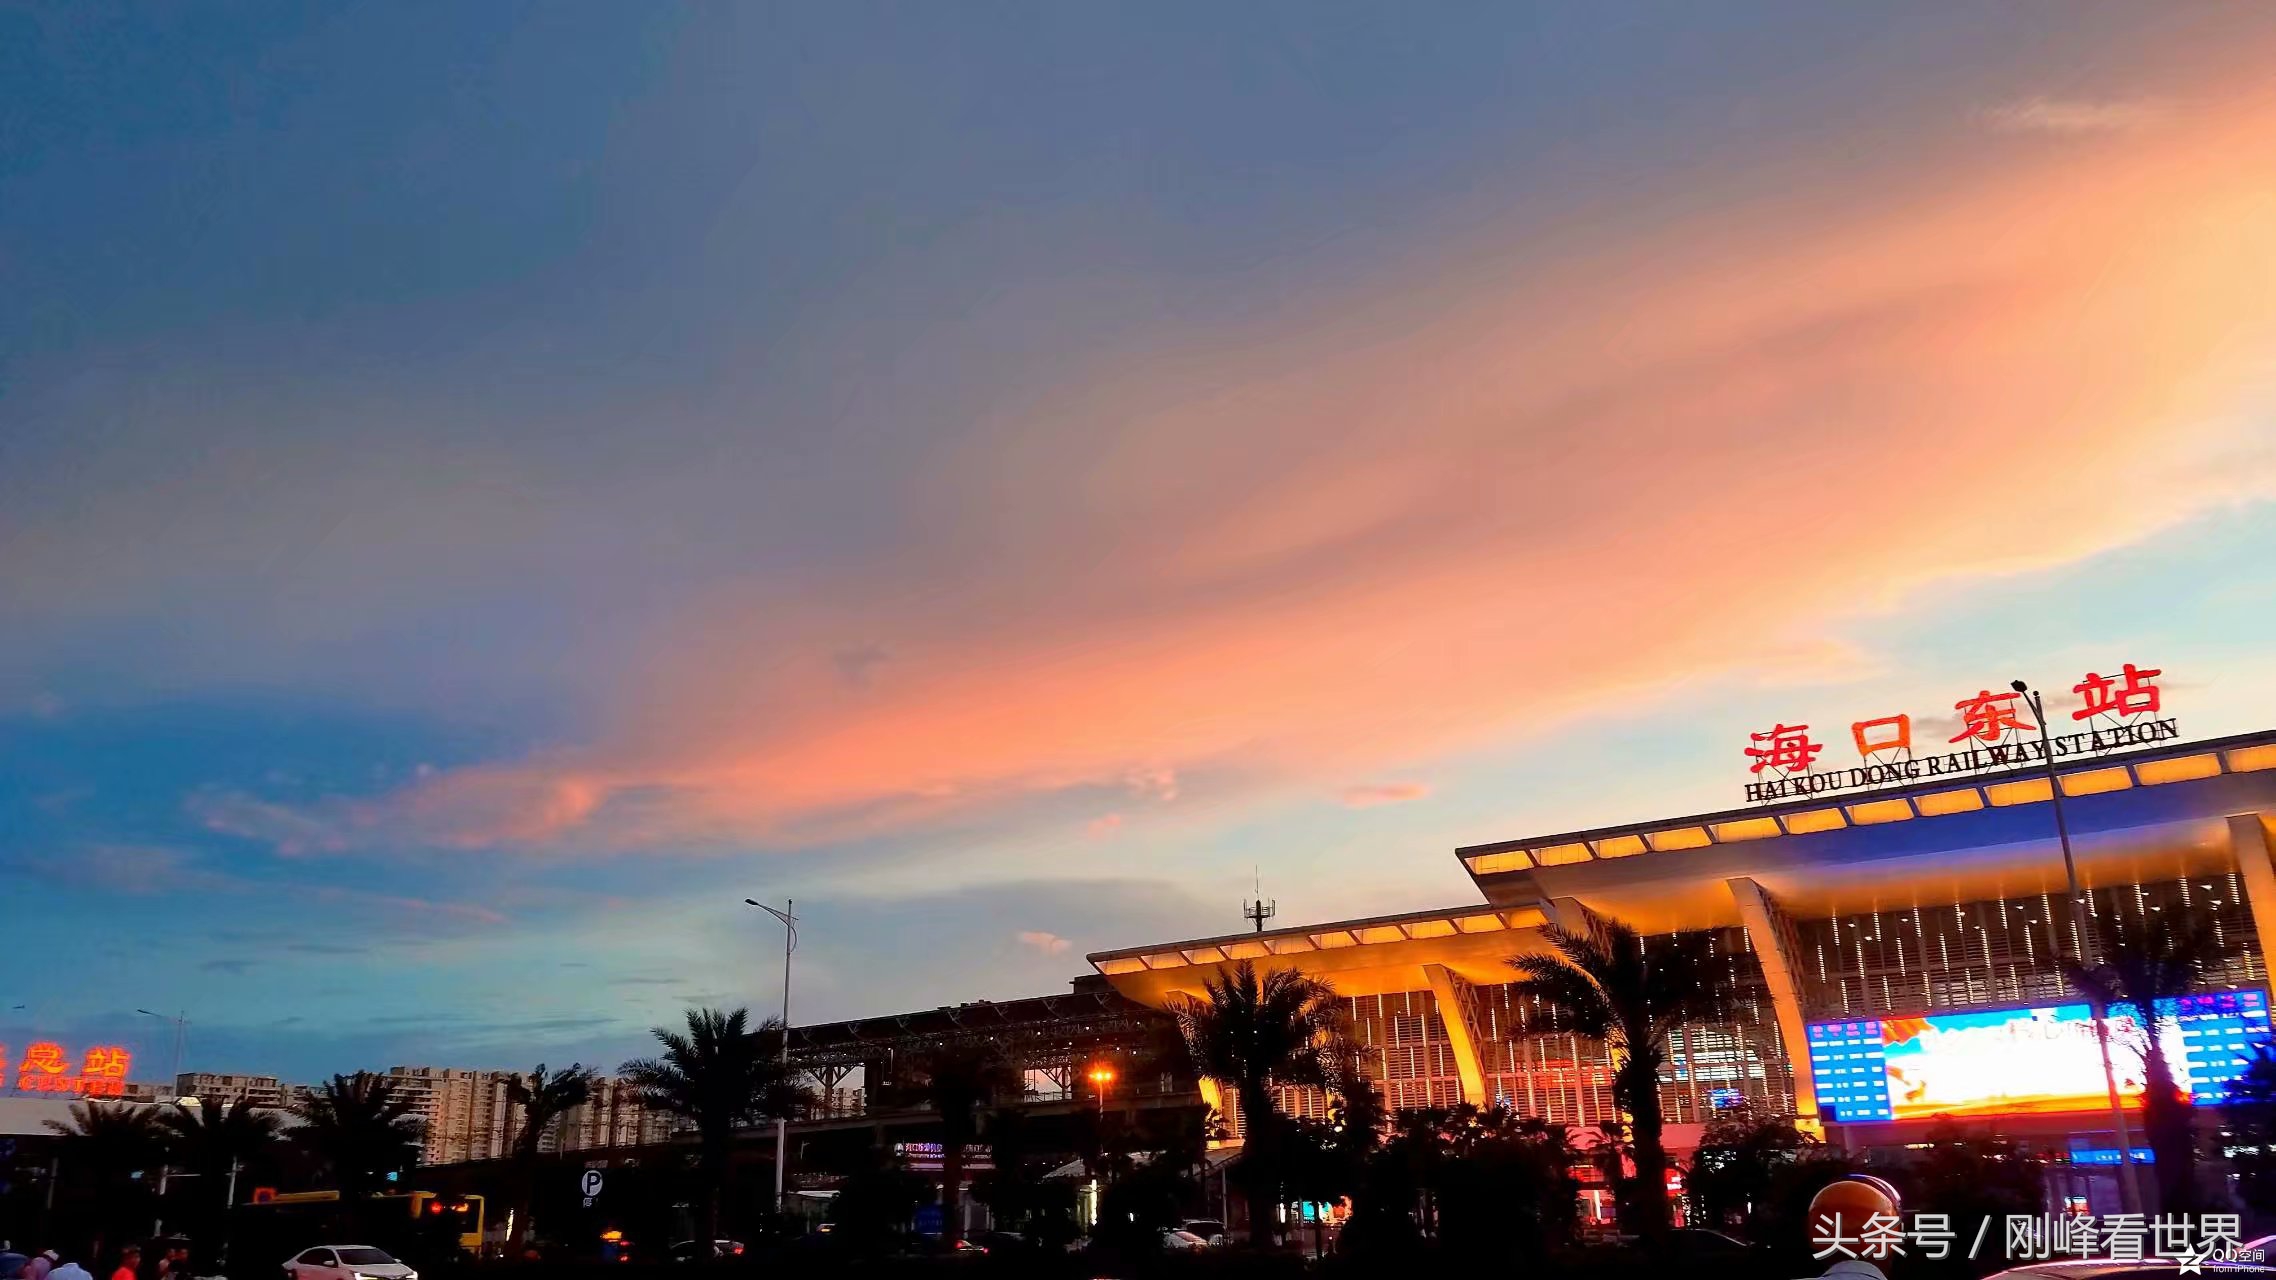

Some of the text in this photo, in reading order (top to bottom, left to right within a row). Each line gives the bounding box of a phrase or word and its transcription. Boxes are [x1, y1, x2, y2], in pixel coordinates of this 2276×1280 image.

[1744, 663, 2161, 773] 海口东站
[1851, 760, 1920, 787] DONG
[1927, 740, 2045, 776] RAILWAY
[2055, 718, 2179, 756] STATION
[0, 1043, 130, 1078] 总站
